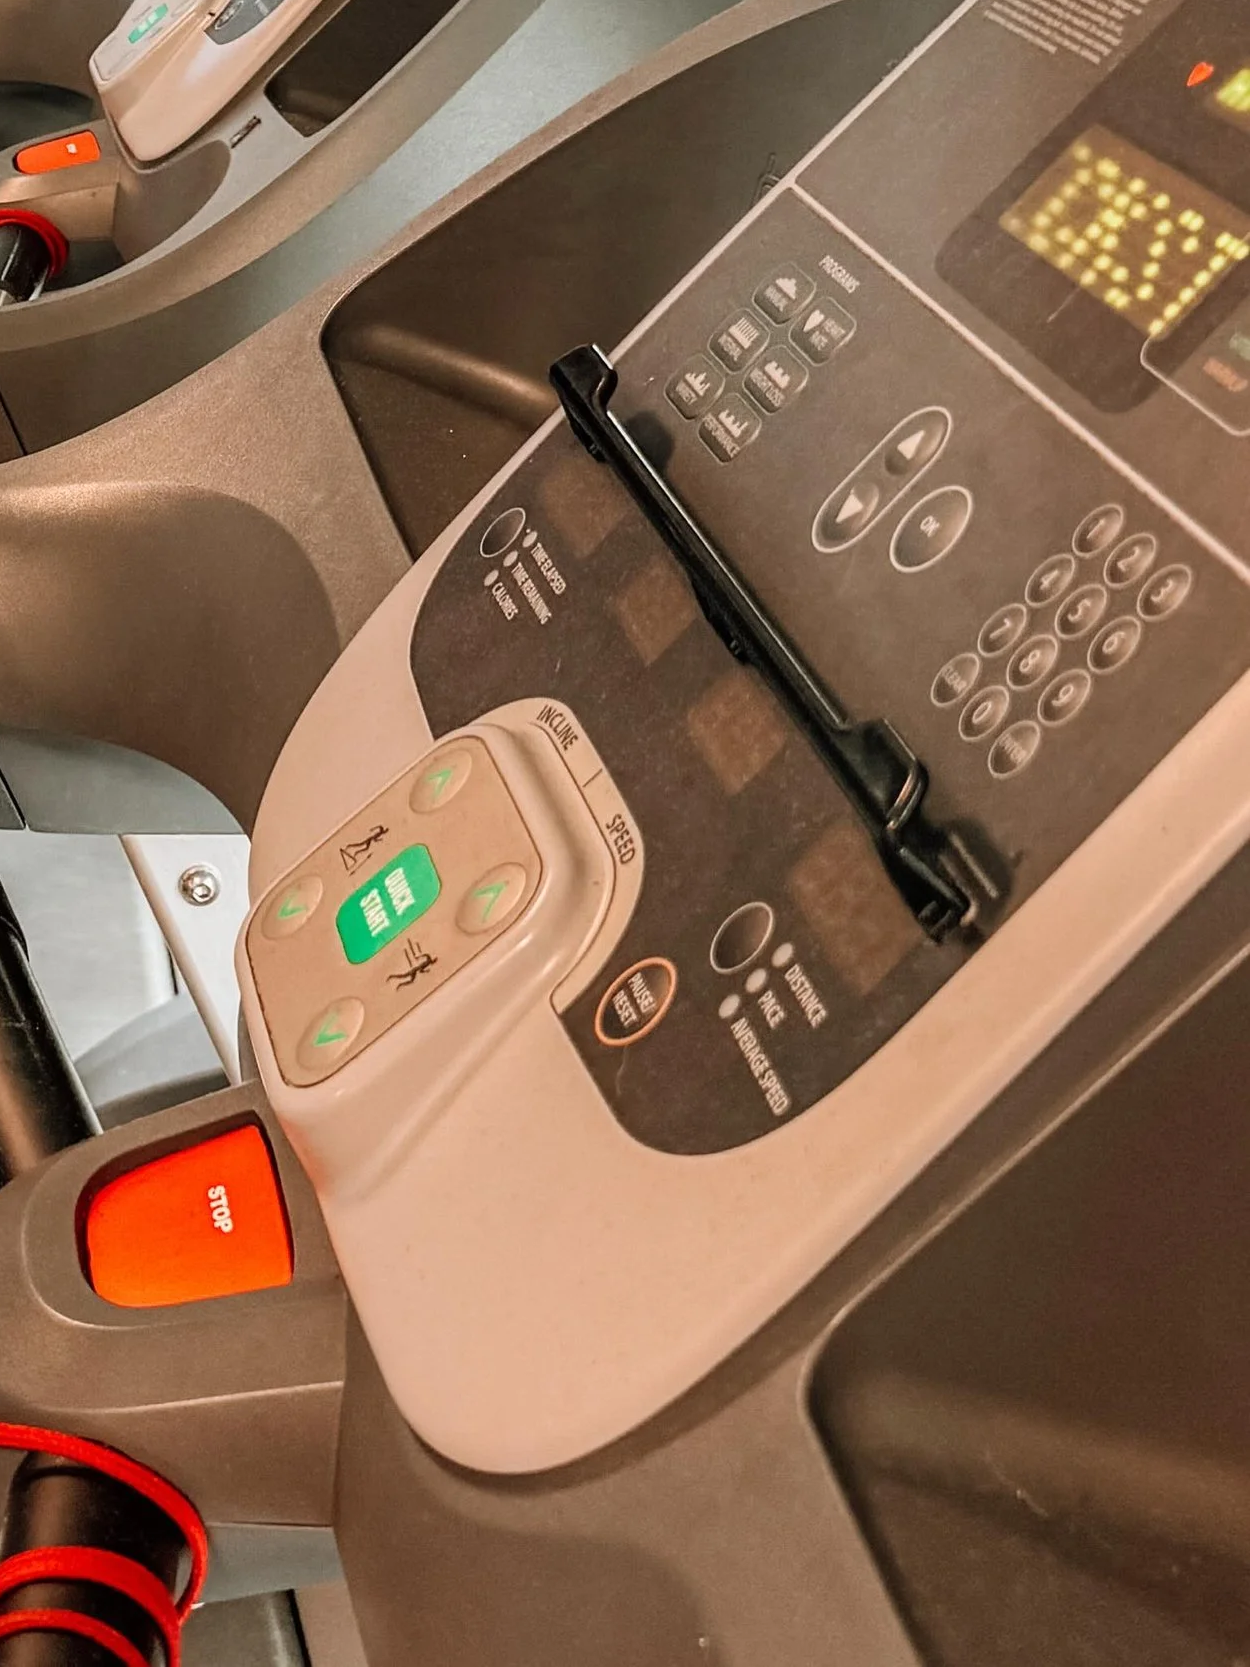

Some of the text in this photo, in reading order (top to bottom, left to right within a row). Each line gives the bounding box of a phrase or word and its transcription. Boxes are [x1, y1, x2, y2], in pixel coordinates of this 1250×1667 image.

[818, 254, 860, 294] PROGRAMS
[702, 413, 741, 459] PERFORMANCE
[920, 514, 940, 537] OK
[530, 542, 567, 595] TIME ELAPSED
[1117, 546, 1139, 572] 2
[511, 561, 552, 625] TIME REMAINING
[1039, 569, 1060, 590] 4
[1150, 578, 1174, 603] 3
[491, 581, 519, 621] CALORIES
[1066, 598, 1091, 623] 5
[989, 617, 1012, 640] 7
[1101, 631, 1126, 655] 6
[1019, 648, 1042, 674] 8
[972, 700, 993, 725] 0
[1051, 683, 1075, 707] 9
[536, 704, 579, 752] INCLINE
[605, 812, 636, 866] SPEED
[384, 866, 417, 916] QUICK
[359, 887, 391, 938] START
[611, 989, 639, 1028] RESET
[757, 989, 786, 1030] PACE
[784, 962, 828, 1030] DISTANCE
[729, 1016, 791, 1117] AVERAGE SPEED
[207, 1184, 235, 1234] STOP
